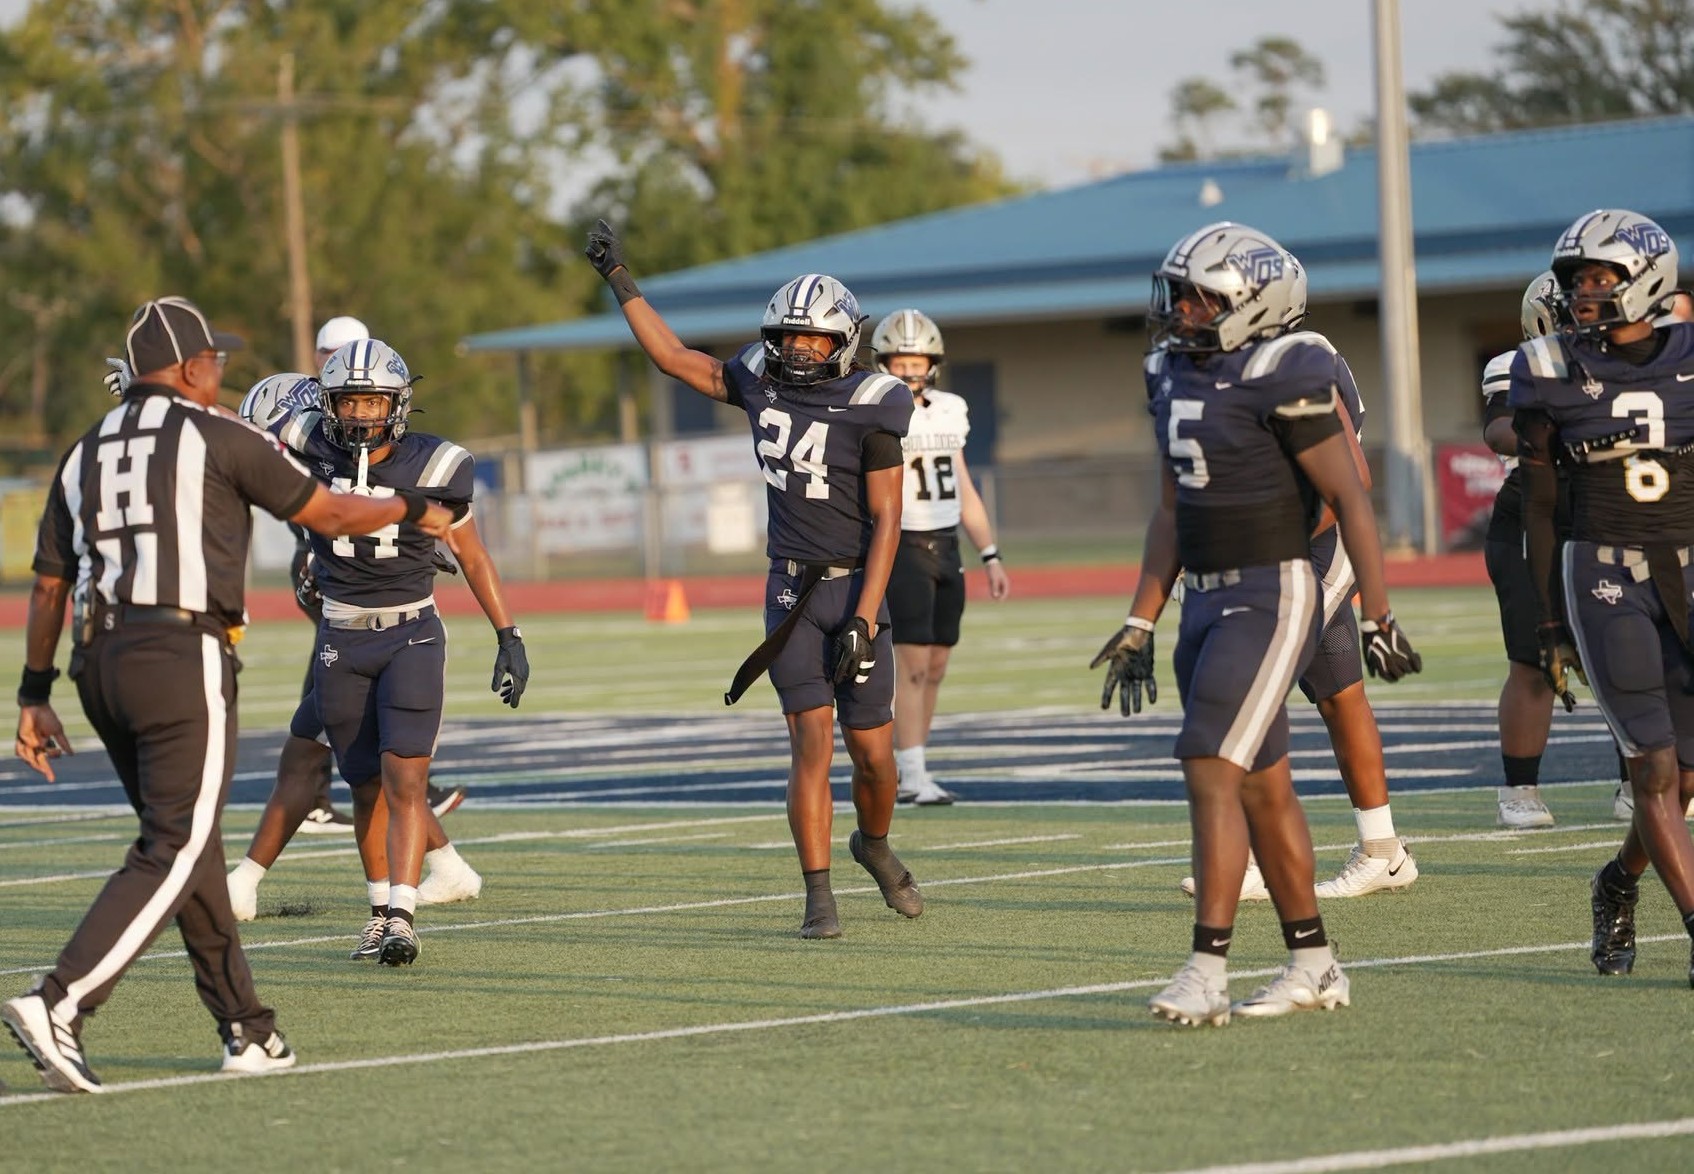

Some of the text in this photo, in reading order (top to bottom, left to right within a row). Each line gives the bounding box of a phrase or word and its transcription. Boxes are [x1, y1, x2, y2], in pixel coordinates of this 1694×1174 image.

[1614, 222, 1671, 257] WOS
[1223, 247, 1284, 291] WOS
[782, 317, 811, 326] Riddell
[1611, 391, 1665, 449] 3
[757, 407, 830, 500] 24
[1167, 398, 1210, 489] 5
[97, 436, 157, 532] H
[911, 455, 956, 501] 12
[1317, 964, 1339, 995] NIKE
